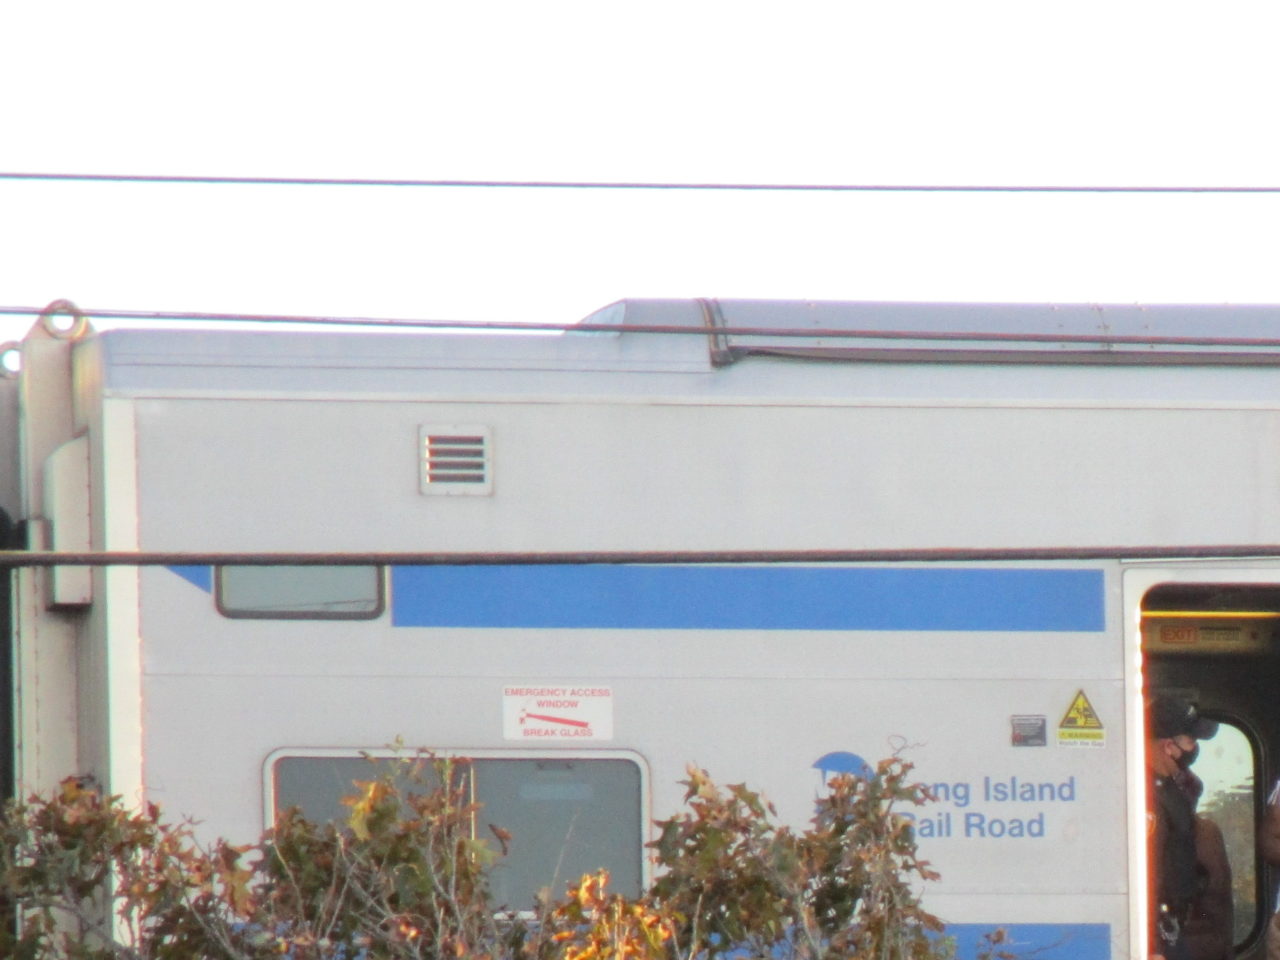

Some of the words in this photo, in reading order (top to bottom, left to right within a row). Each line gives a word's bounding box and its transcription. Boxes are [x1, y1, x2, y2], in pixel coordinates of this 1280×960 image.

[504, 688, 567, 697] EMERGENCY
[570, 688, 610, 697] ACCESS
[536, 700, 579, 708] WINDOW
[523, 728, 557, 737] BREAK
[560, 728, 593, 737] GLASS
[984, 776, 1076, 801] Island
[964, 812, 1045, 838] Road
